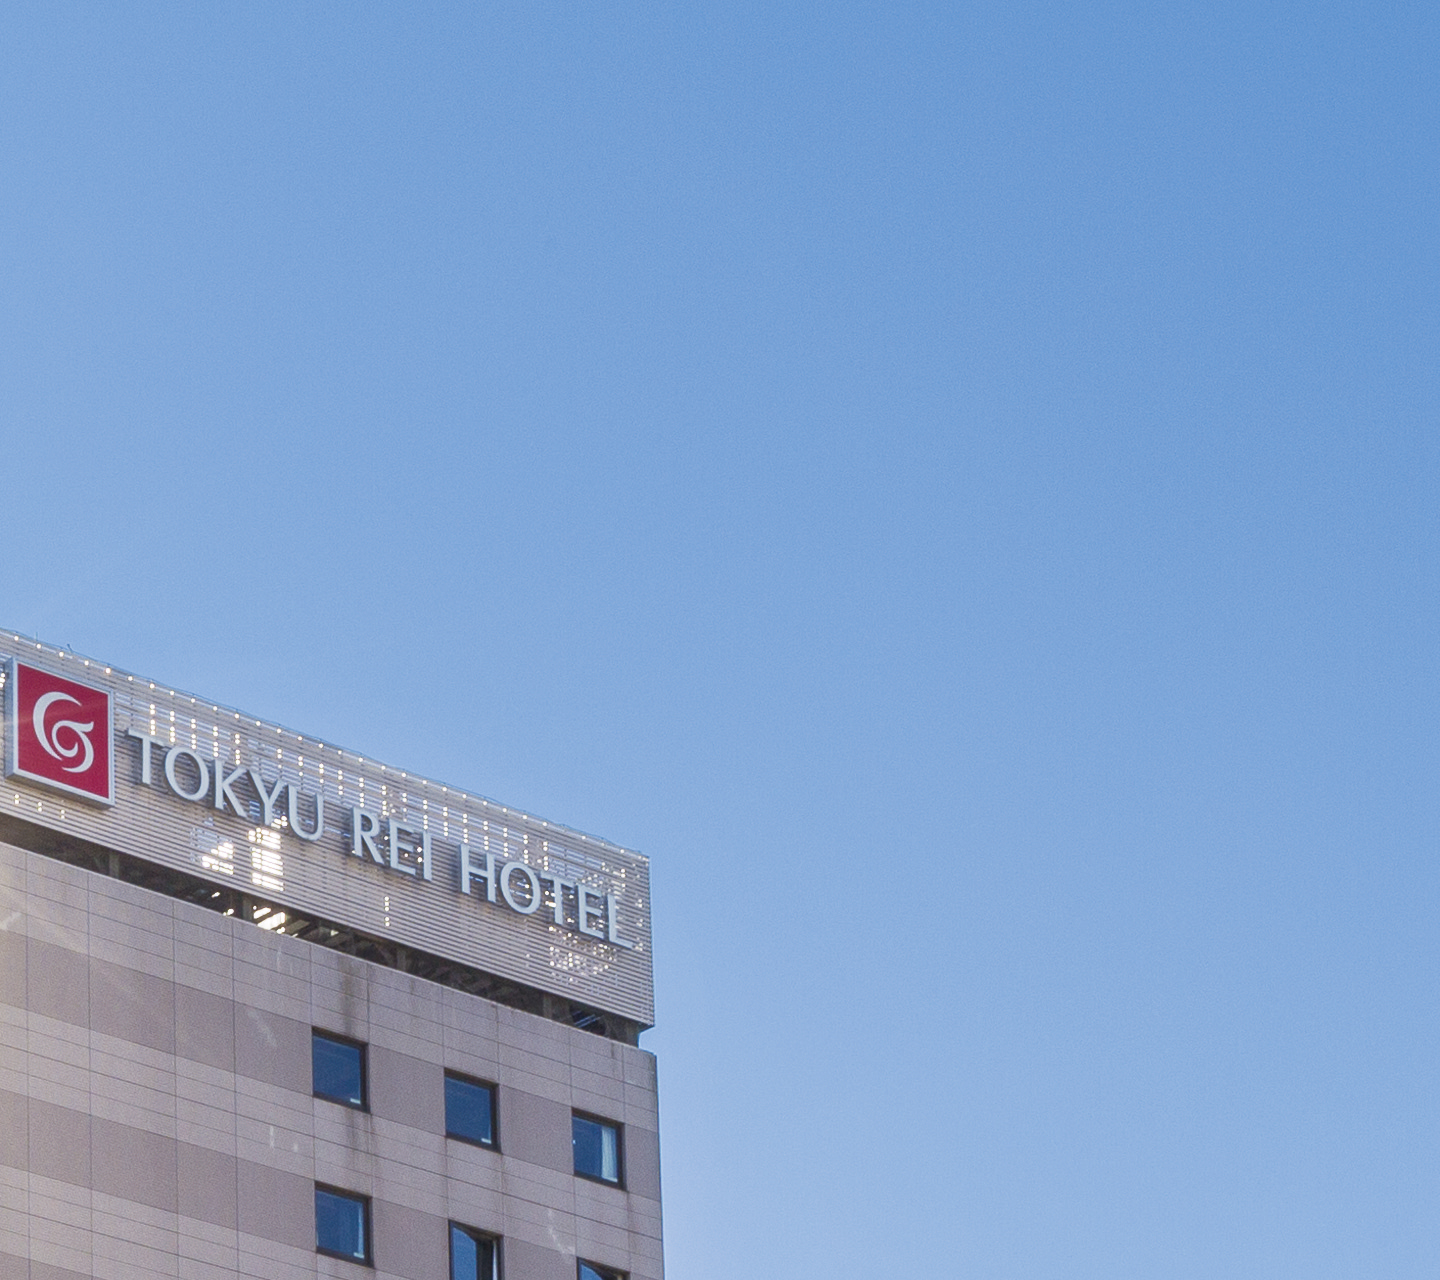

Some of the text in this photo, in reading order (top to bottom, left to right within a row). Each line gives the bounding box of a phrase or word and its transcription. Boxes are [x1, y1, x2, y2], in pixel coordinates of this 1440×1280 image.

[126, 727, 634, 950] TOKYU REI HOTEL
